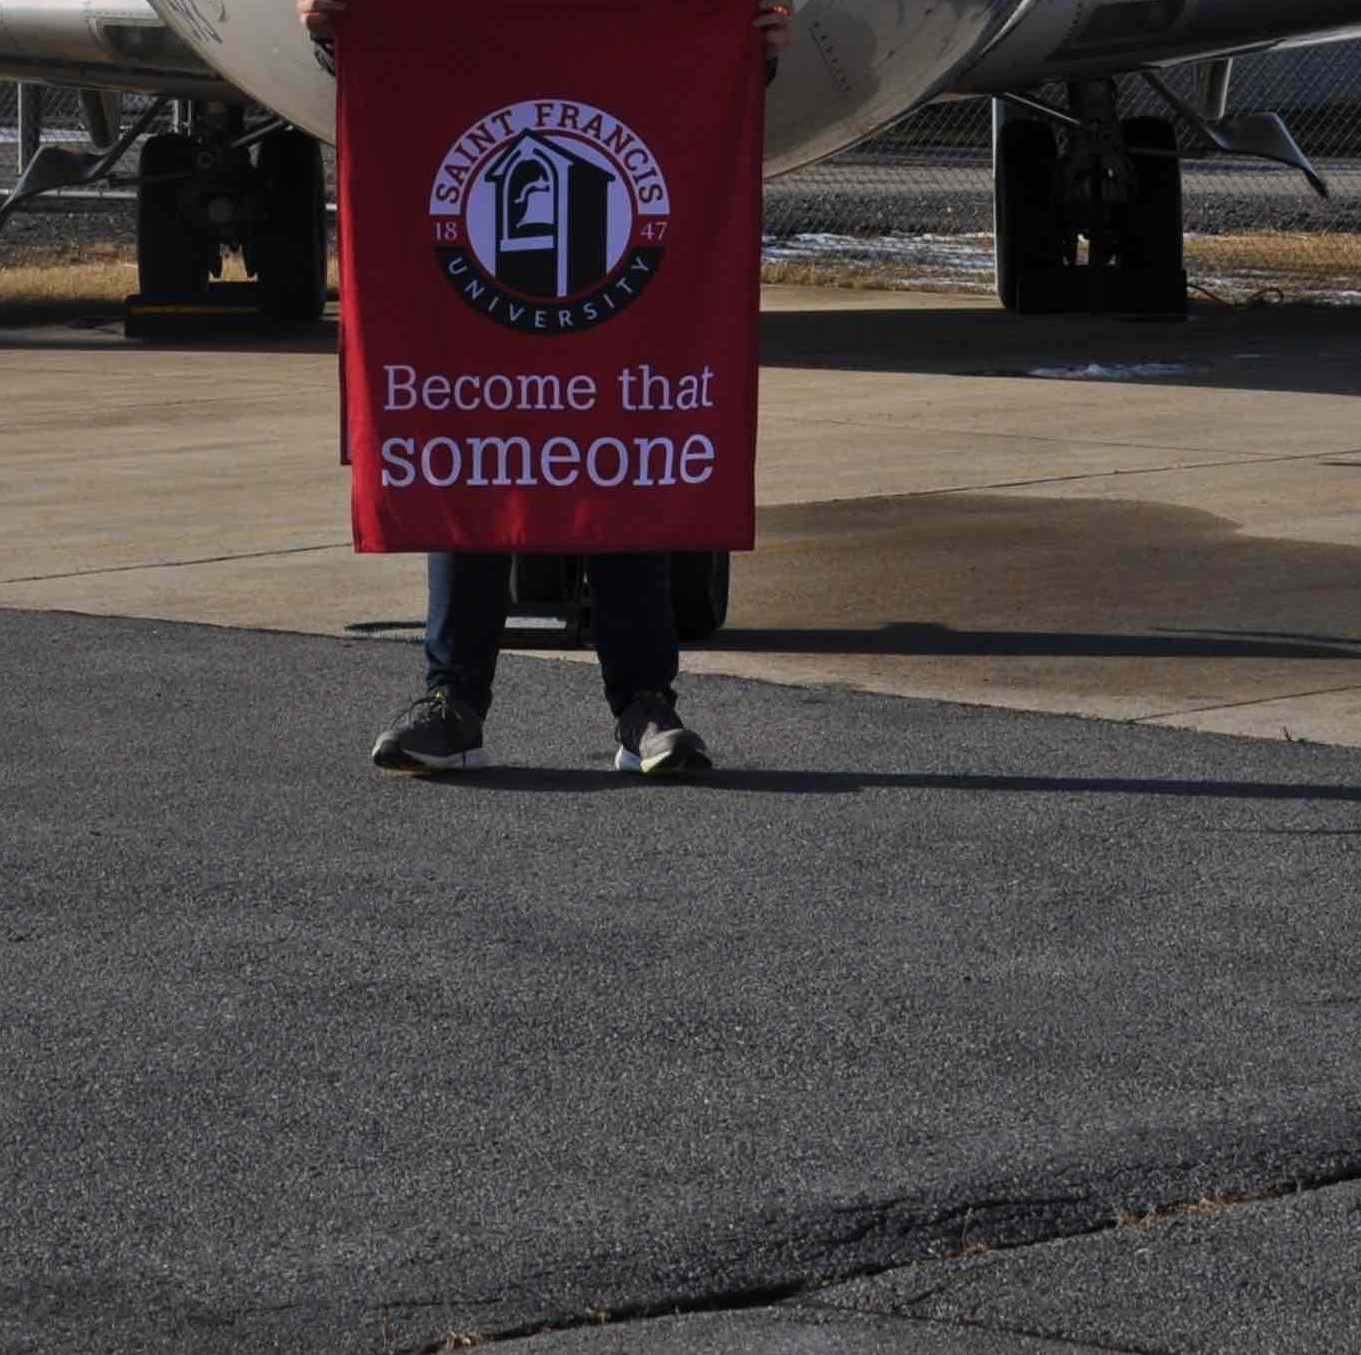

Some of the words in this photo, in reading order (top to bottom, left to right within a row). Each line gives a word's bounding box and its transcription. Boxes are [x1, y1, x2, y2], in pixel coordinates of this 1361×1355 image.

[435, 109, 513, 204] SAINT
[534, 102, 664, 204] FRANCIS
[434, 221, 458, 242] 18
[639, 221, 668, 242] 47
[448, 257, 649, 329] UNIVERSITY
[382, 364, 597, 411] Become
[617, 364, 714, 411] that
[381, 433, 715, 487] someone
